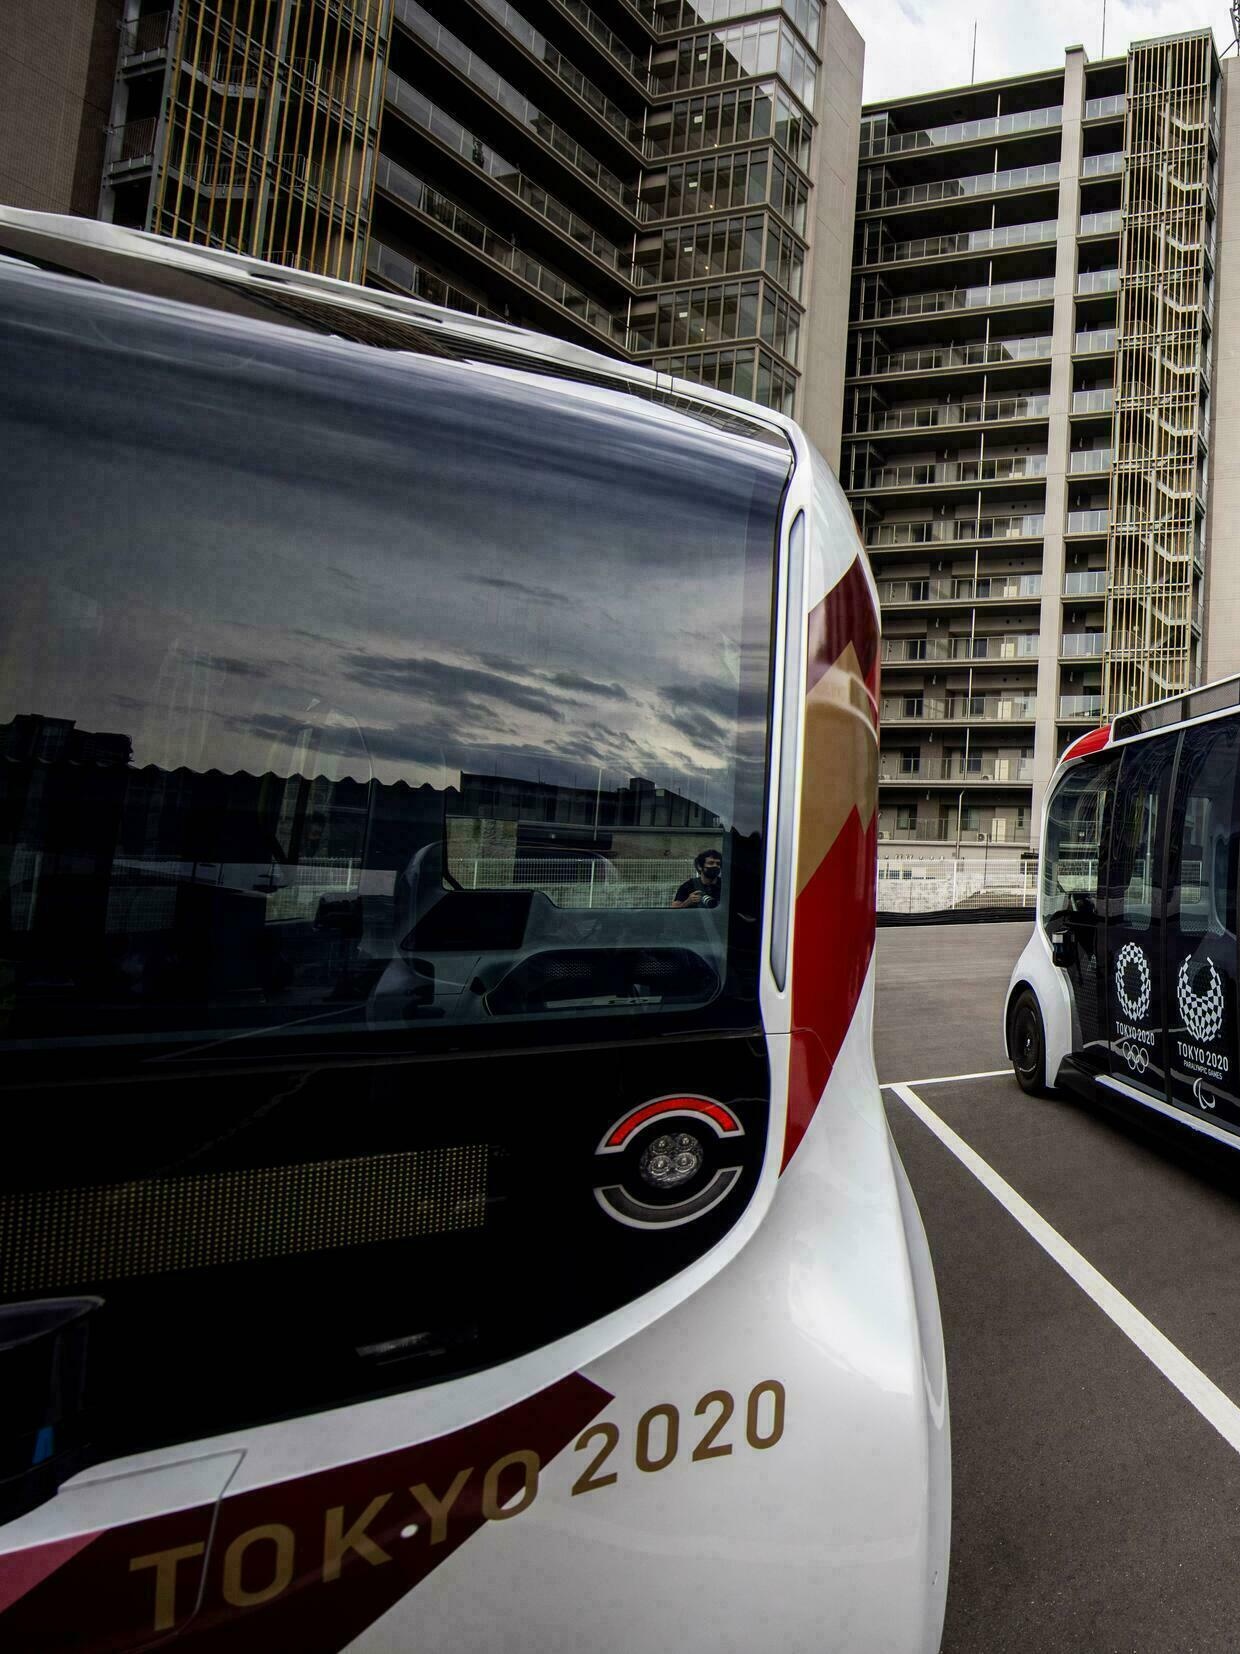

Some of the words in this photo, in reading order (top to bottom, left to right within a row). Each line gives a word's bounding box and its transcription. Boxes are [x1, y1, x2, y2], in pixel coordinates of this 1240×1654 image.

[1115, 1020, 1137, 1040] TOKYO
[1137, 1028, 1155, 1046] 2020
[1177, 1041, 1205, 1064] TOKYO
[1205, 1050, 1229, 1072] 2020
[1183, 1059, 1208, 1075] PARALYMPIC
[1207, 1068, 1223, 1080] GAMES
[129, 1448, 541, 1633] TOKYO
[570, 1378, 787, 1497] 2020
